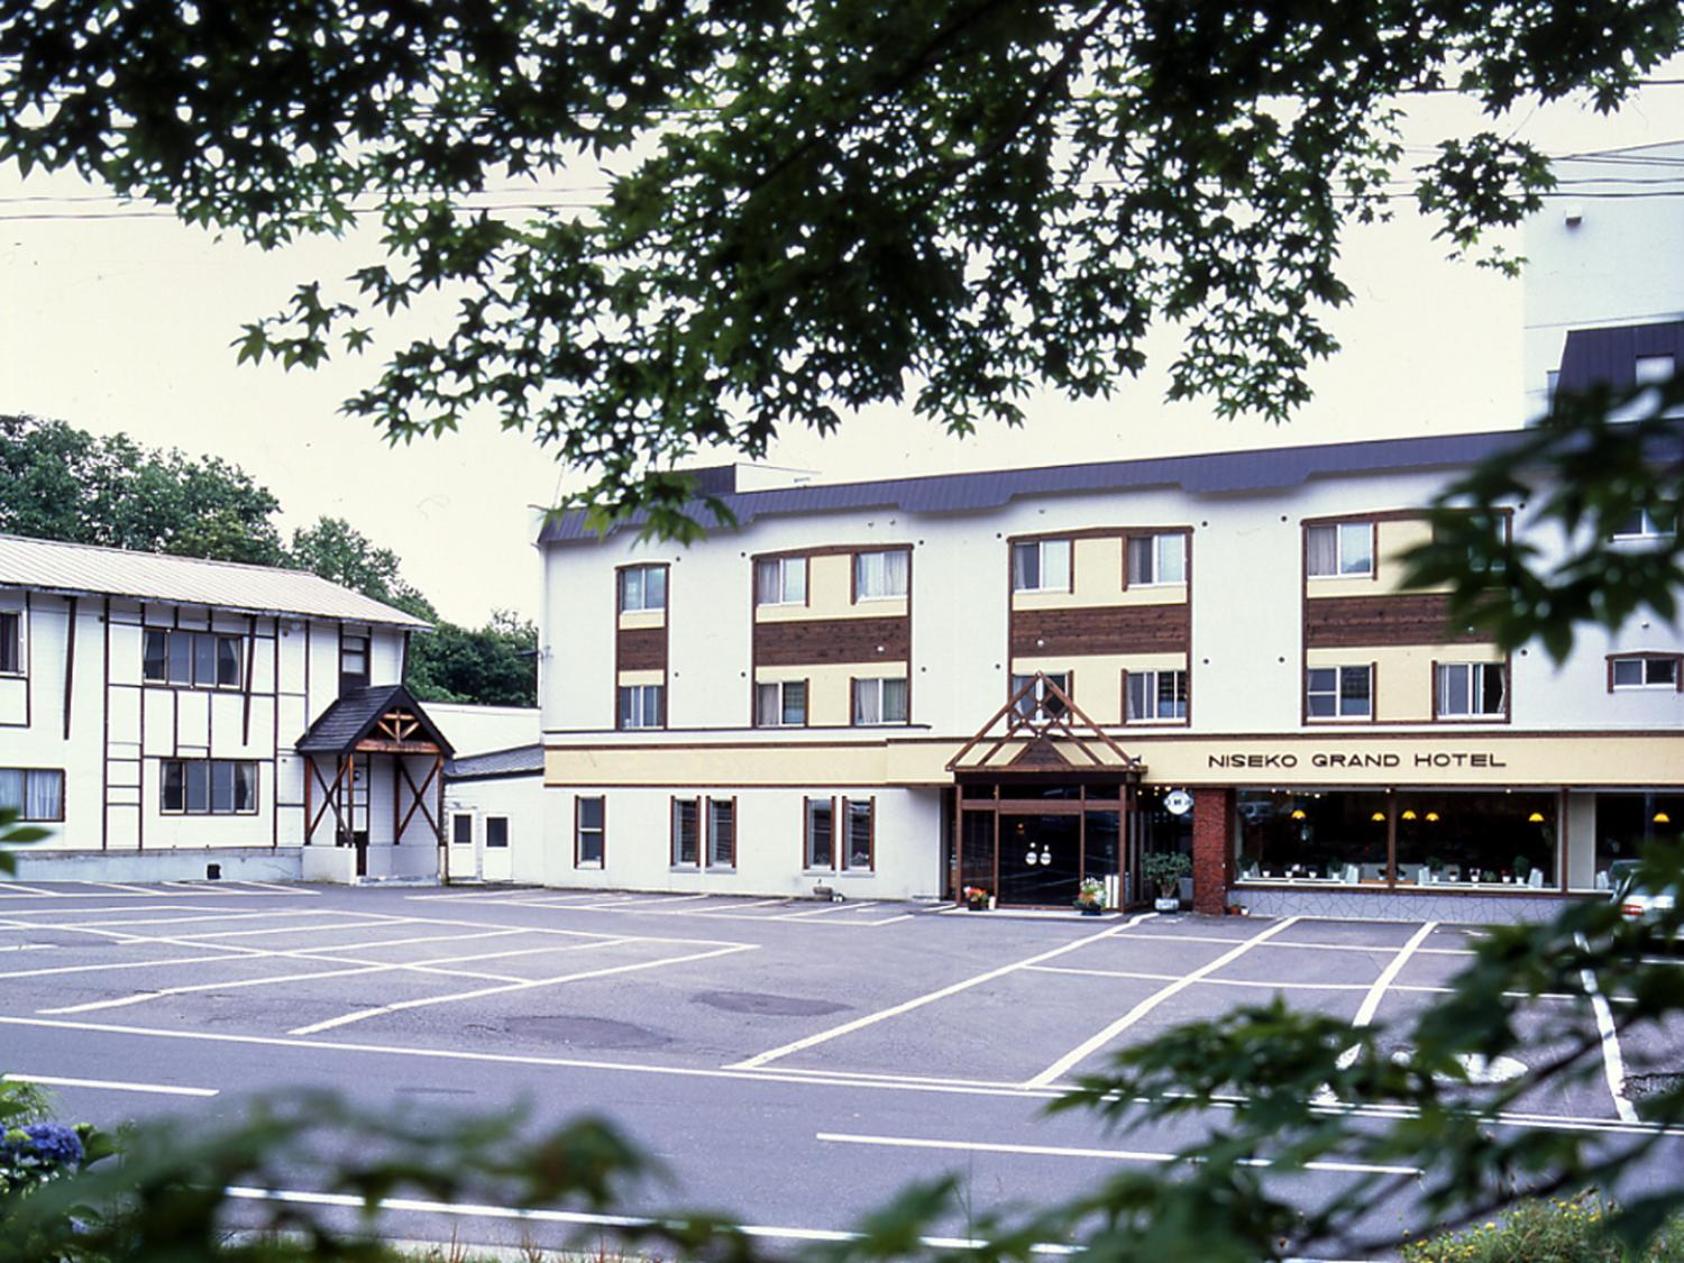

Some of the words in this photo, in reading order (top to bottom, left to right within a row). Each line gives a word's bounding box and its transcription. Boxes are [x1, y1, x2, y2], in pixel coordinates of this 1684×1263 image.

[1208, 754, 1298, 768] NISEKO
[1311, 753, 1401, 768] GRAND
[1414, 753, 1507, 768] HOTEL
